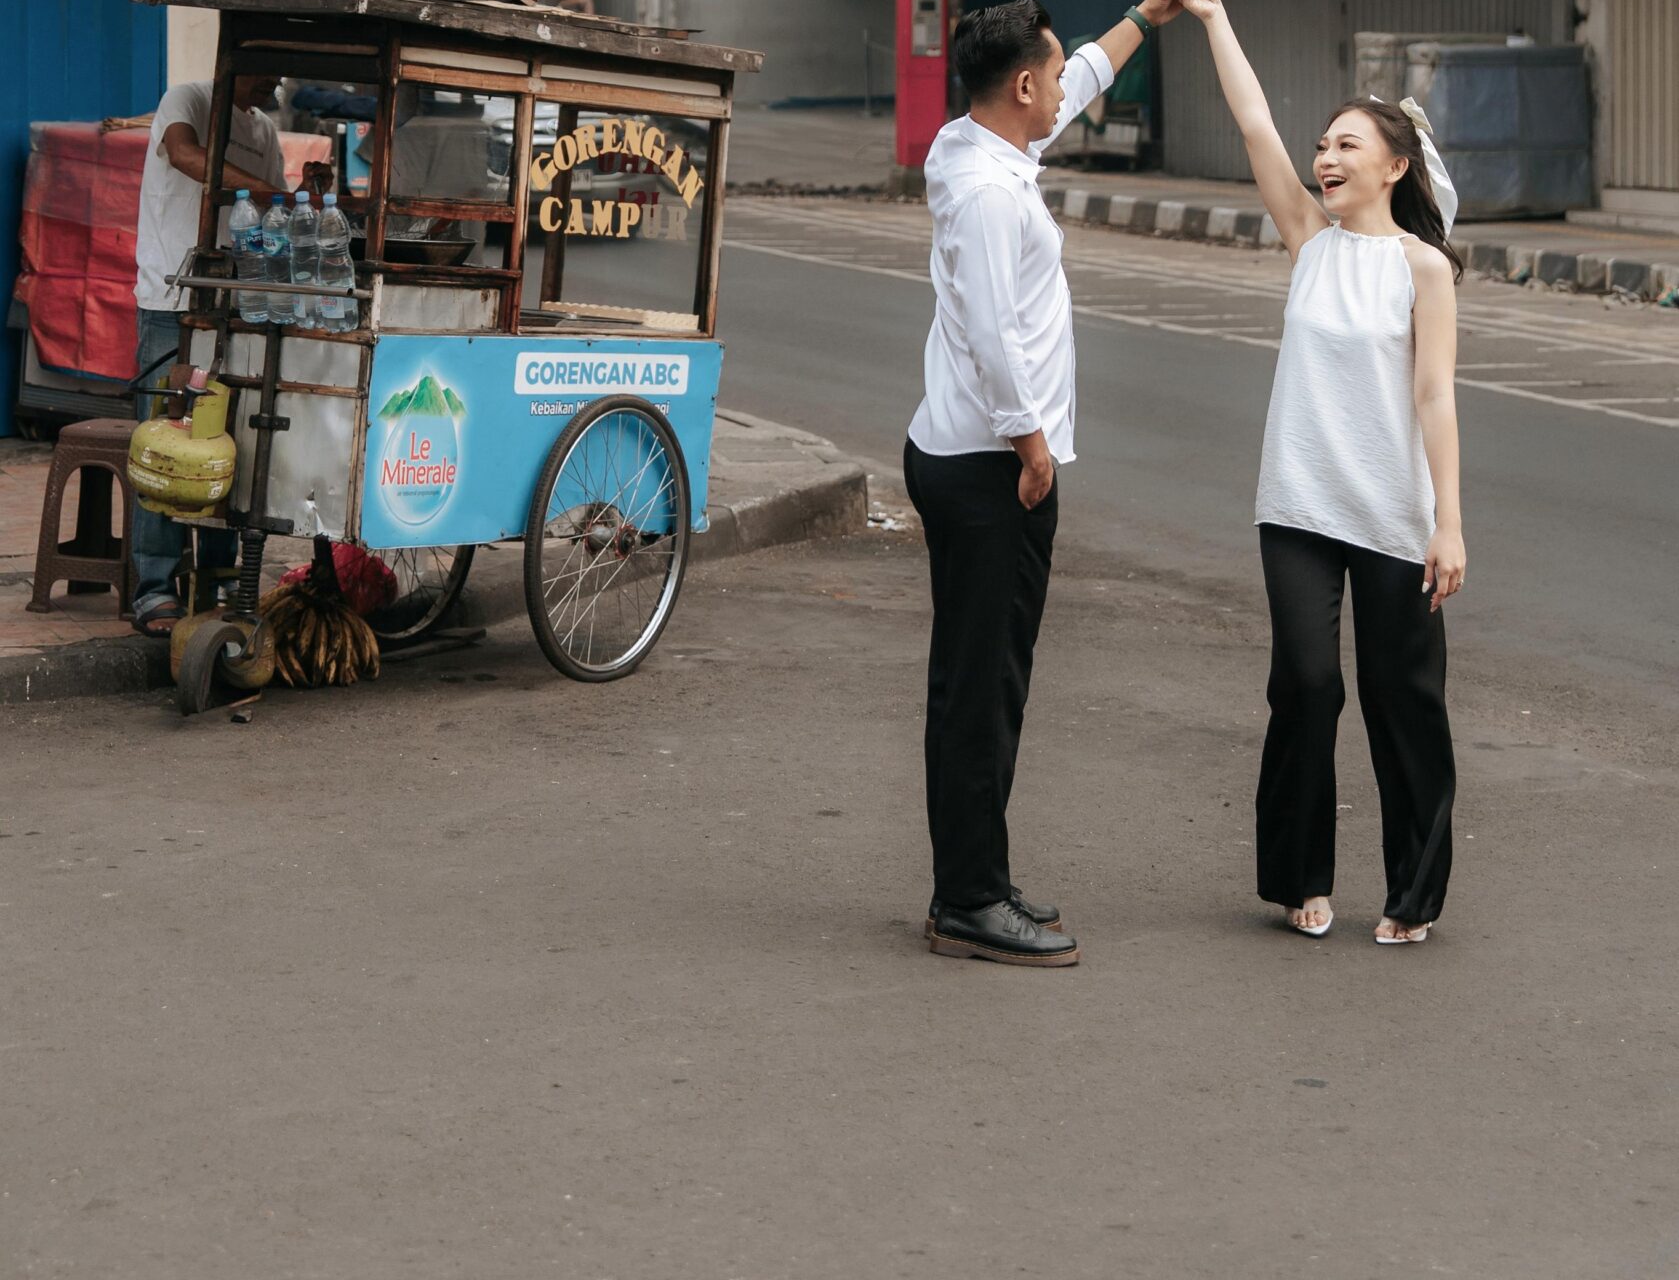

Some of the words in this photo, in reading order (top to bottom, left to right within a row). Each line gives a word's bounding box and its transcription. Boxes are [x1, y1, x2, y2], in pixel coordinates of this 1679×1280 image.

[530, 118, 705, 209] GORENGAN
[539, 196, 689, 241] CAMPUR
[525, 361, 637, 386] GORENGAN
[639, 363, 681, 386] ABC
[530, 400, 574, 417] Kebaikan
[411, 432, 431, 461] Le
[381, 457, 456, 486] Minerale
